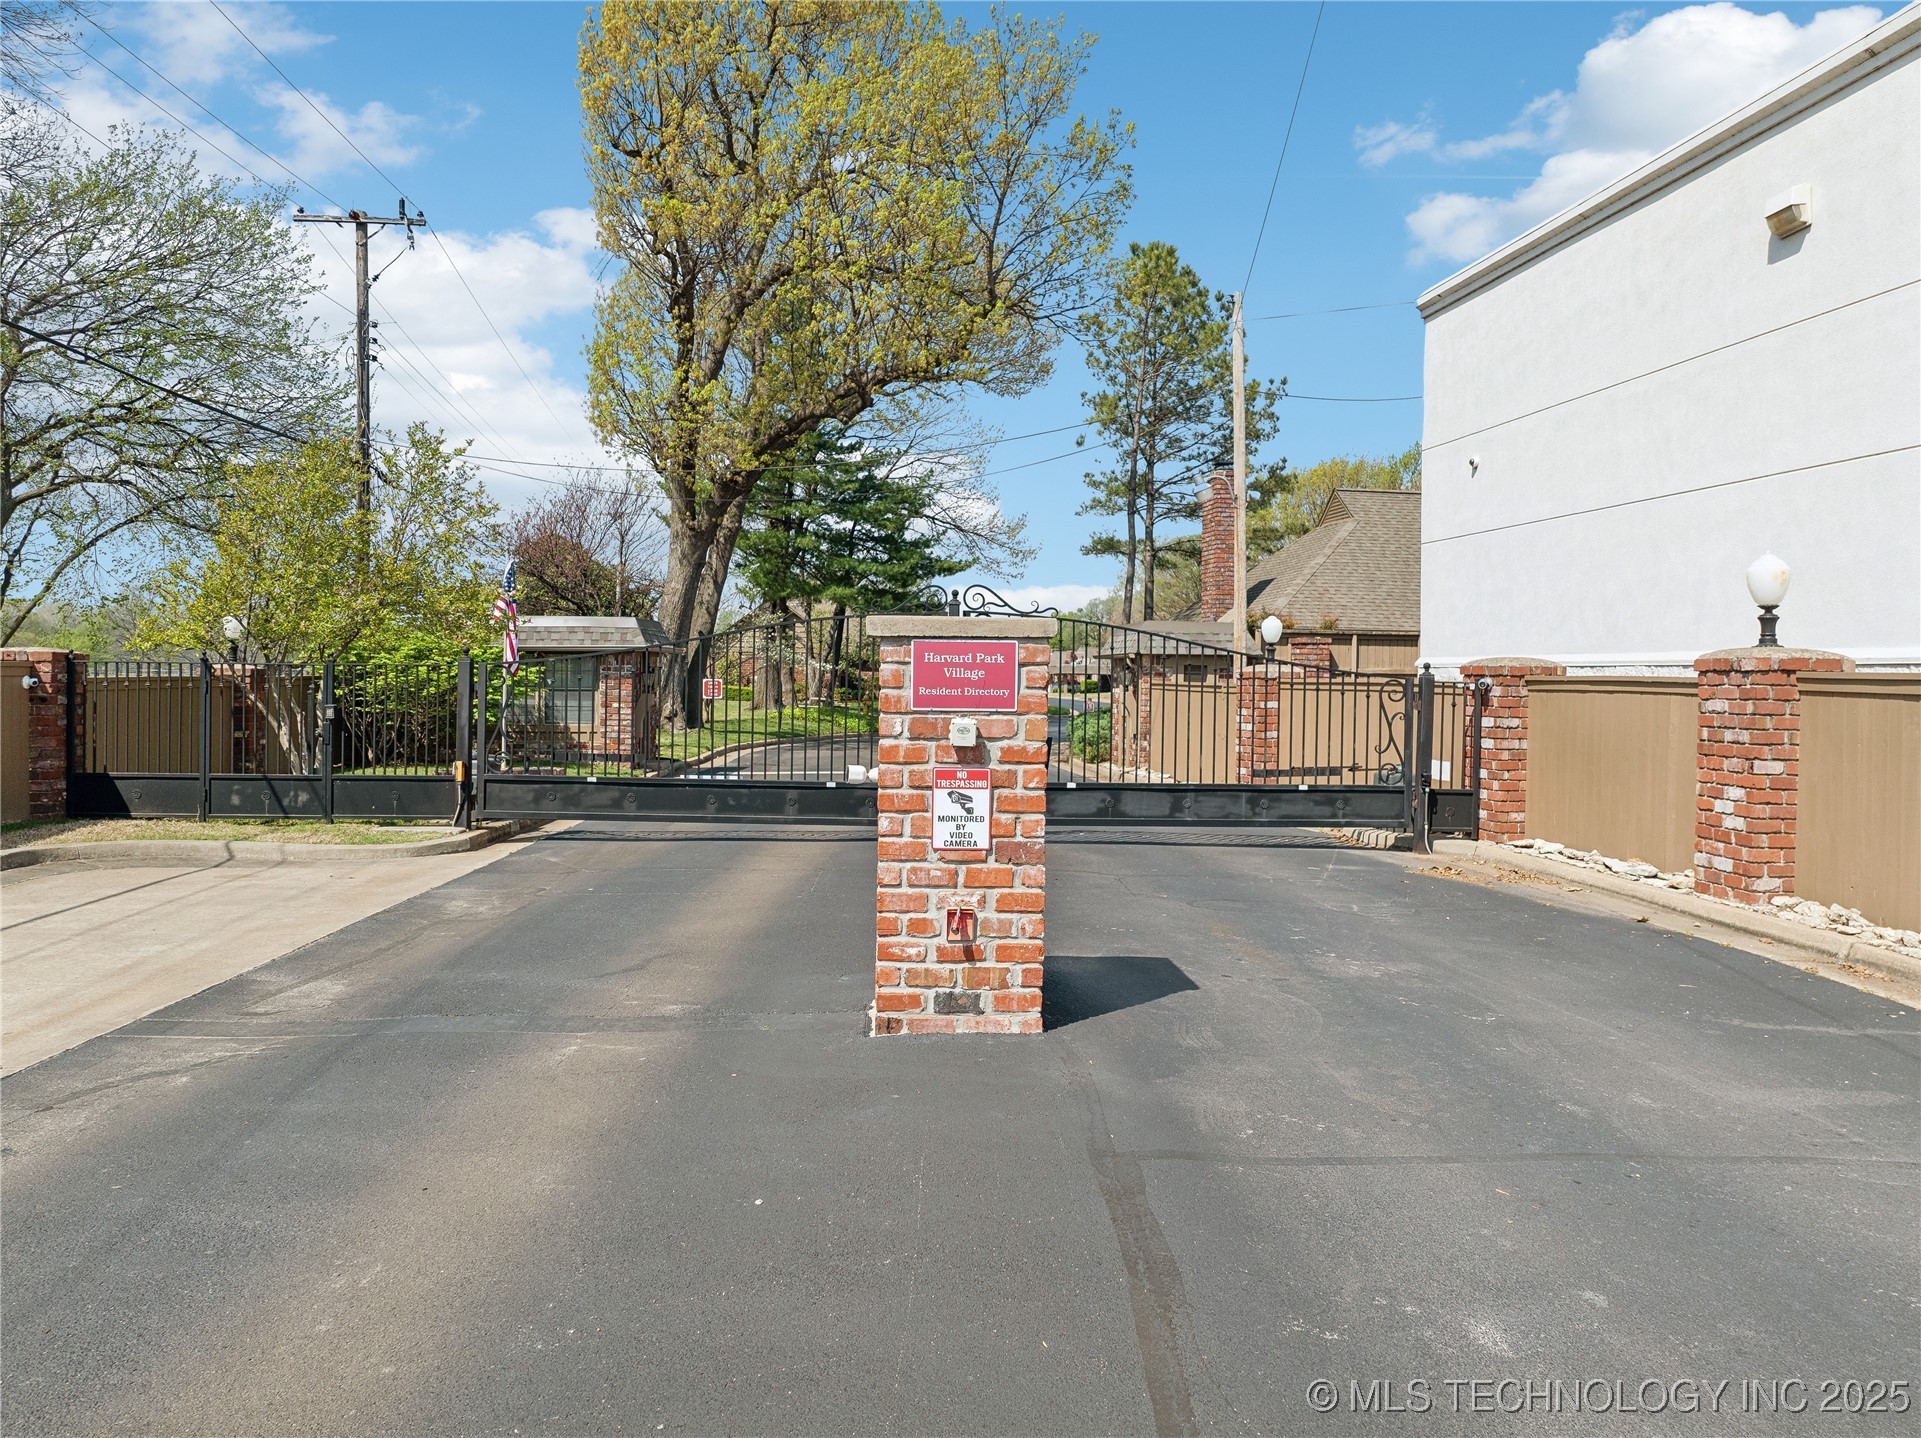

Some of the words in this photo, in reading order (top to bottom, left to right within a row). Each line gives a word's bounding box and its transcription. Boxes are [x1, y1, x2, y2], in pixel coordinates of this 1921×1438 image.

[924, 652, 973, 663] Harvard
[976, 652, 1005, 663] Park
[944, 668, 985, 680] Village
[919, 687, 962, 695] Resident
[964, 687, 1010, 697] Directory
[957, 771, 967, 779] NO
[937, 780, 986, 788] TRESPASSING
[937, 815, 985, 823] MONITORED
[943, 840, 978, 848] CAMERA
